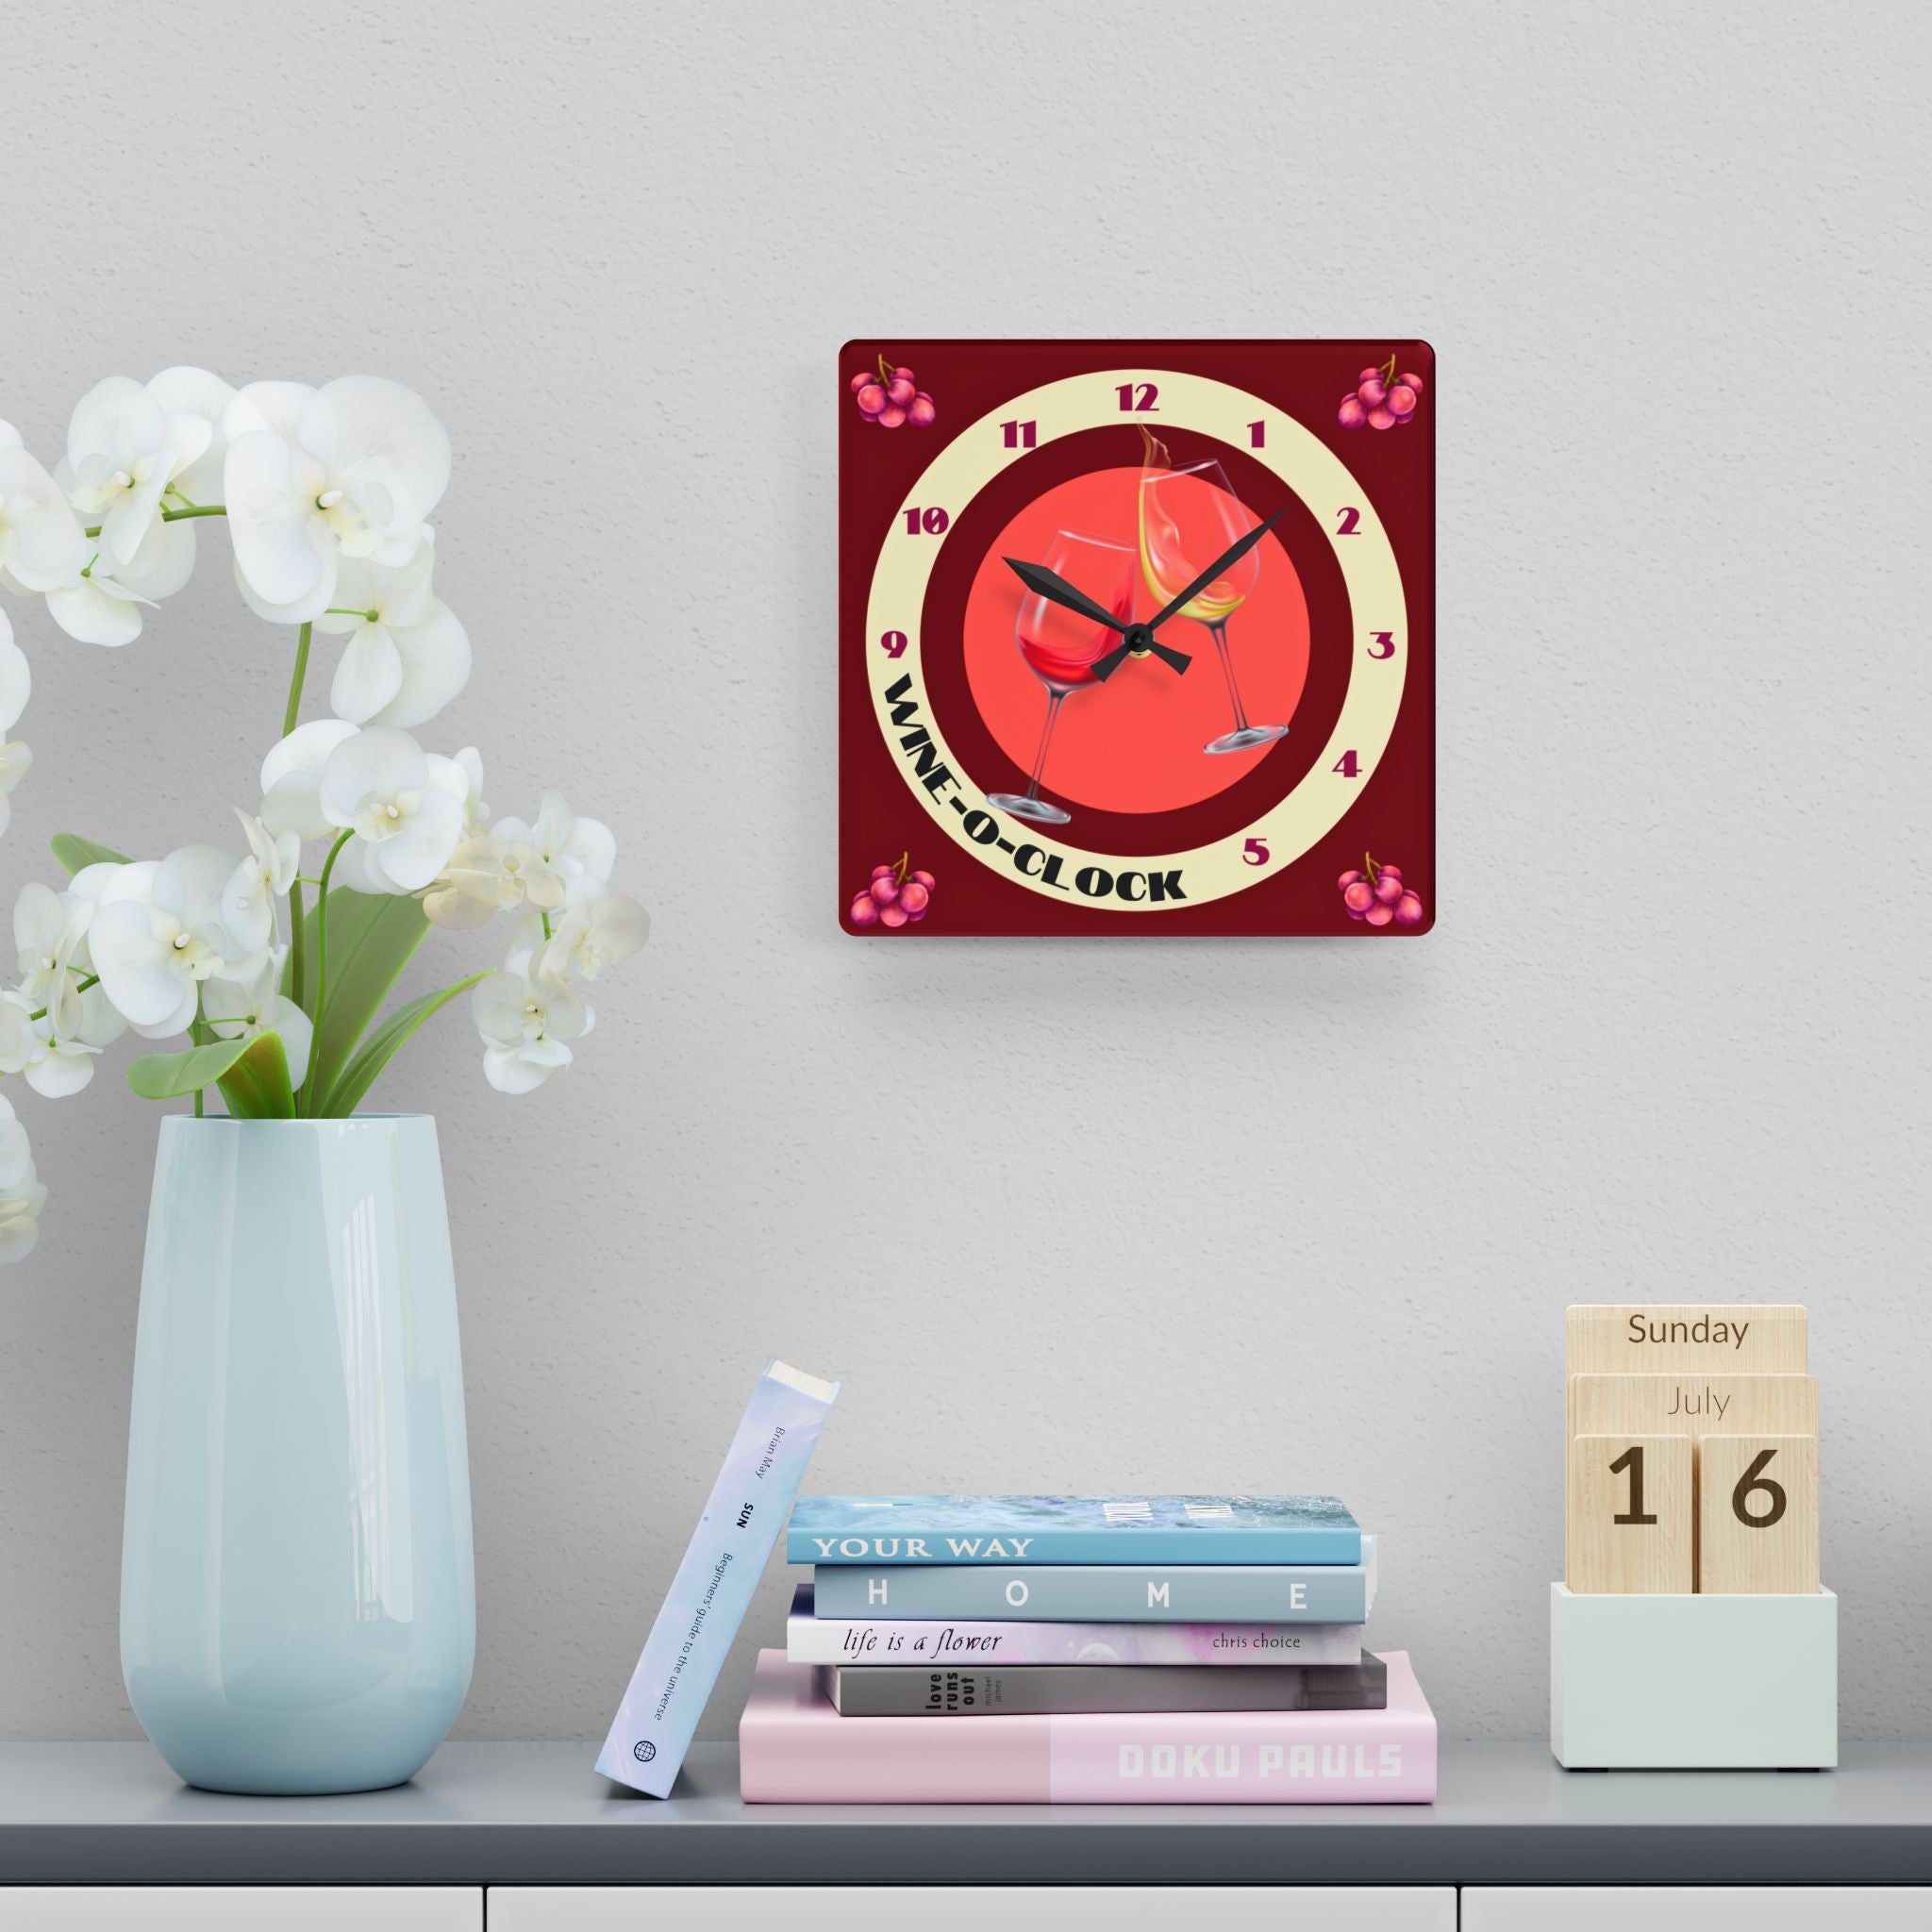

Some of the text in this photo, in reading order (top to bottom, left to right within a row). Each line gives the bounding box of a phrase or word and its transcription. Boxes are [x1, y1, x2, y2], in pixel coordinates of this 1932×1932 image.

[1115, 382, 1159, 411] 12
[1000, 420, 1037, 448] 11
[1246, 420, 1266, 448] 1
[903, 507, 949, 535] 10
[1337, 507, 1361, 535] 2
[881, 630, 908, 658] 9
[1367, 632, 1395, 659] 3
[1332, 750, 1363, 778] 4
[884, 673, 1188, 903] WINE-O-CLOCK
[1242, 838, 1270, 866] 5
[1628, 1313, 1749, 1350] Sunday
[1667, 1386, 1731, 1421] July
[755, 1426, 786, 1479] Brian May
[1608, 1446, 1787, 1528] 1 6
[737, 1502, 754, 1528] SUN
[811, 1538, 1035, 1557] YOUR WAY
[689, 1607, 707, 1640] guide
[682, 1641, 693, 1653] to
[843, 1628, 1003, 1659] life is a flower
[1212, 1632, 1300, 1648] chris choice
[674, 1657, 688, 1674] the
[655, 1676, 678, 1721] universe
[925, 1674, 941, 1709] love
[946, 1673, 958, 1710] runs
[961, 1676, 974, 1706] out
[984, 1676, 992, 1707] michael
[1119, 1743, 1403, 1778] DOKU PAULS
